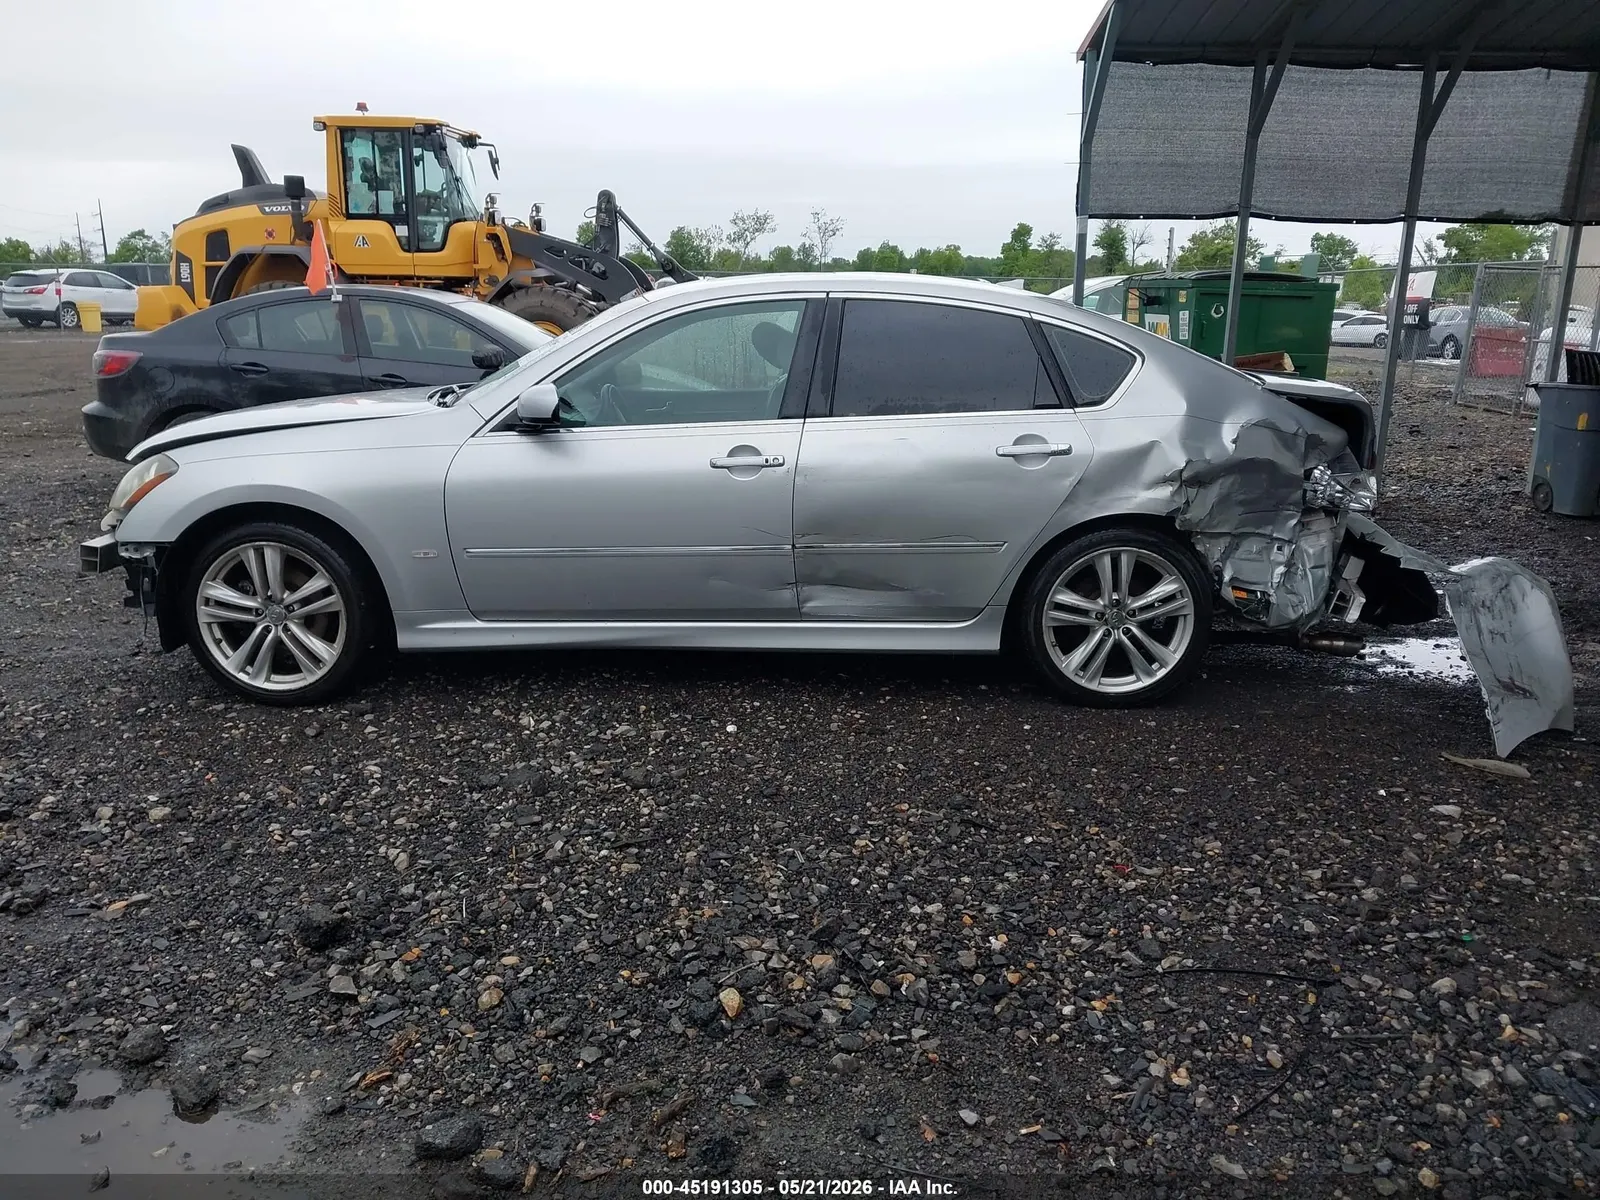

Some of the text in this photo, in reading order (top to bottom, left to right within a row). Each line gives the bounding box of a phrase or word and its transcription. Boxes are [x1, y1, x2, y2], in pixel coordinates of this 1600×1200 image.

[179, 262, 191, 283] L90H
[1407, 304, 1418, 313] OFF
[1403, 315, 1419, 324] ONLY
